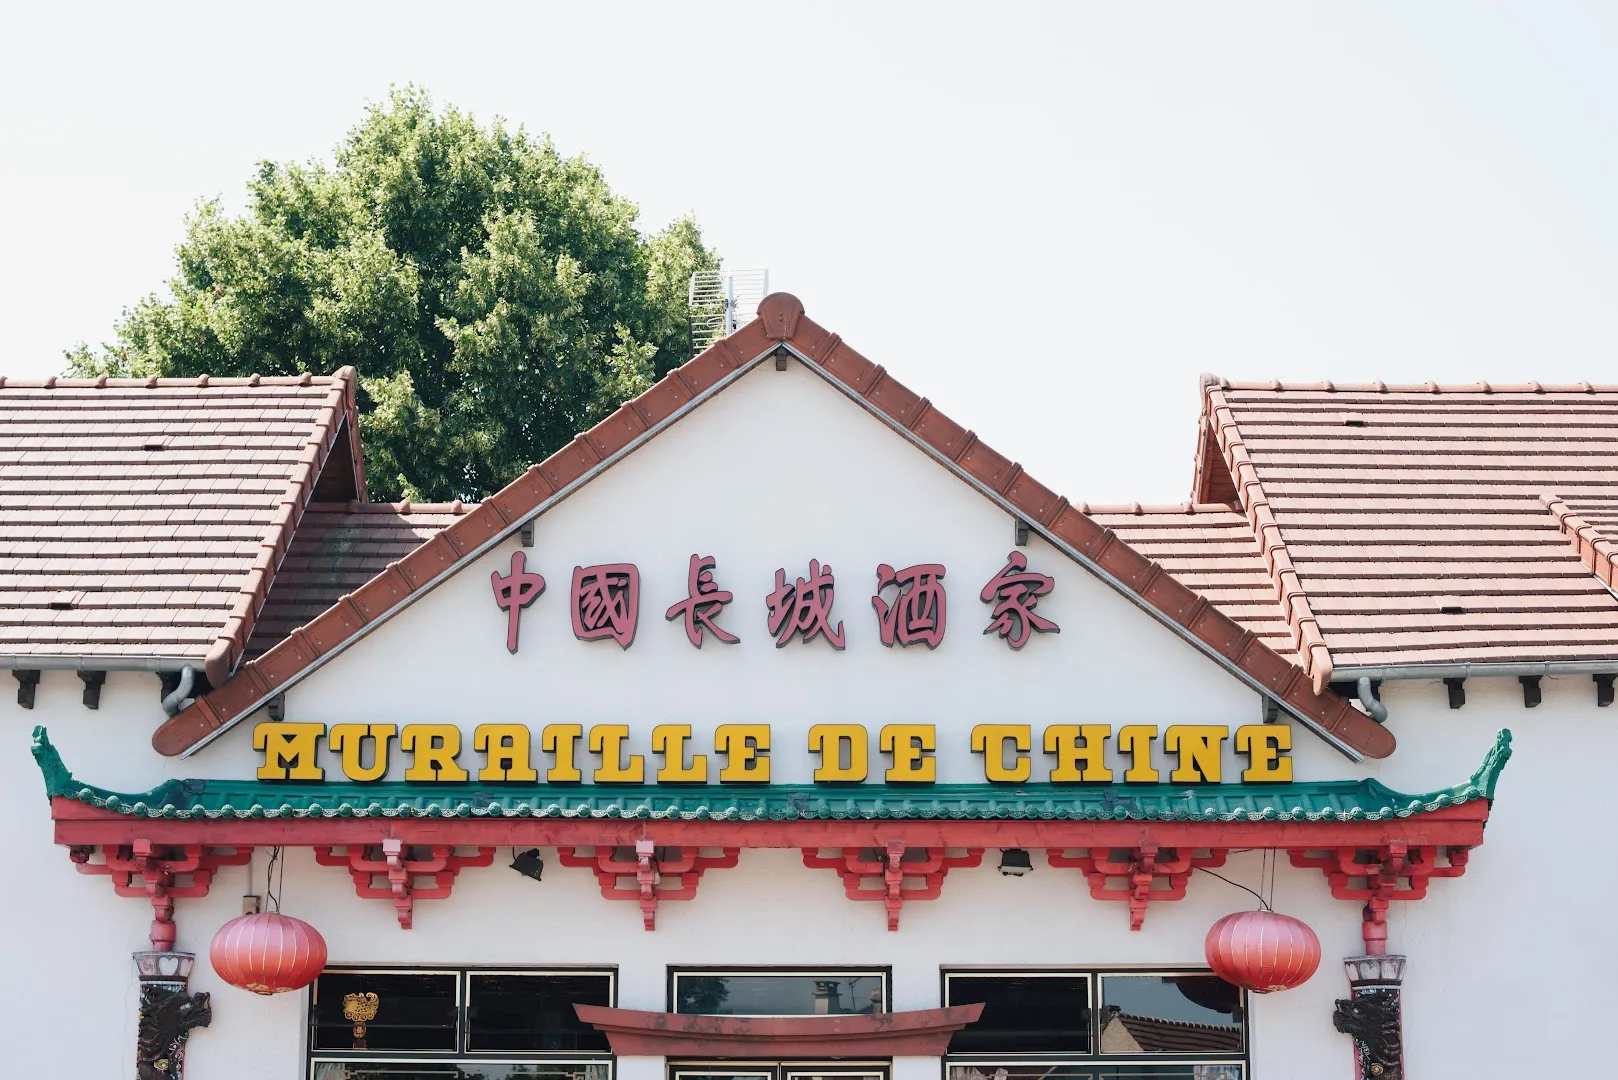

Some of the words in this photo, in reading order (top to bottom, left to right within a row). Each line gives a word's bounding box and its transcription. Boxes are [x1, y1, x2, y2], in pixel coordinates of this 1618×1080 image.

[490, 550, 1060, 654] 中國長城酒家
[252, 722, 772, 784] MURAILLE
[808, 723, 936, 784] DE
[970, 723, 1294, 784] CHINE
